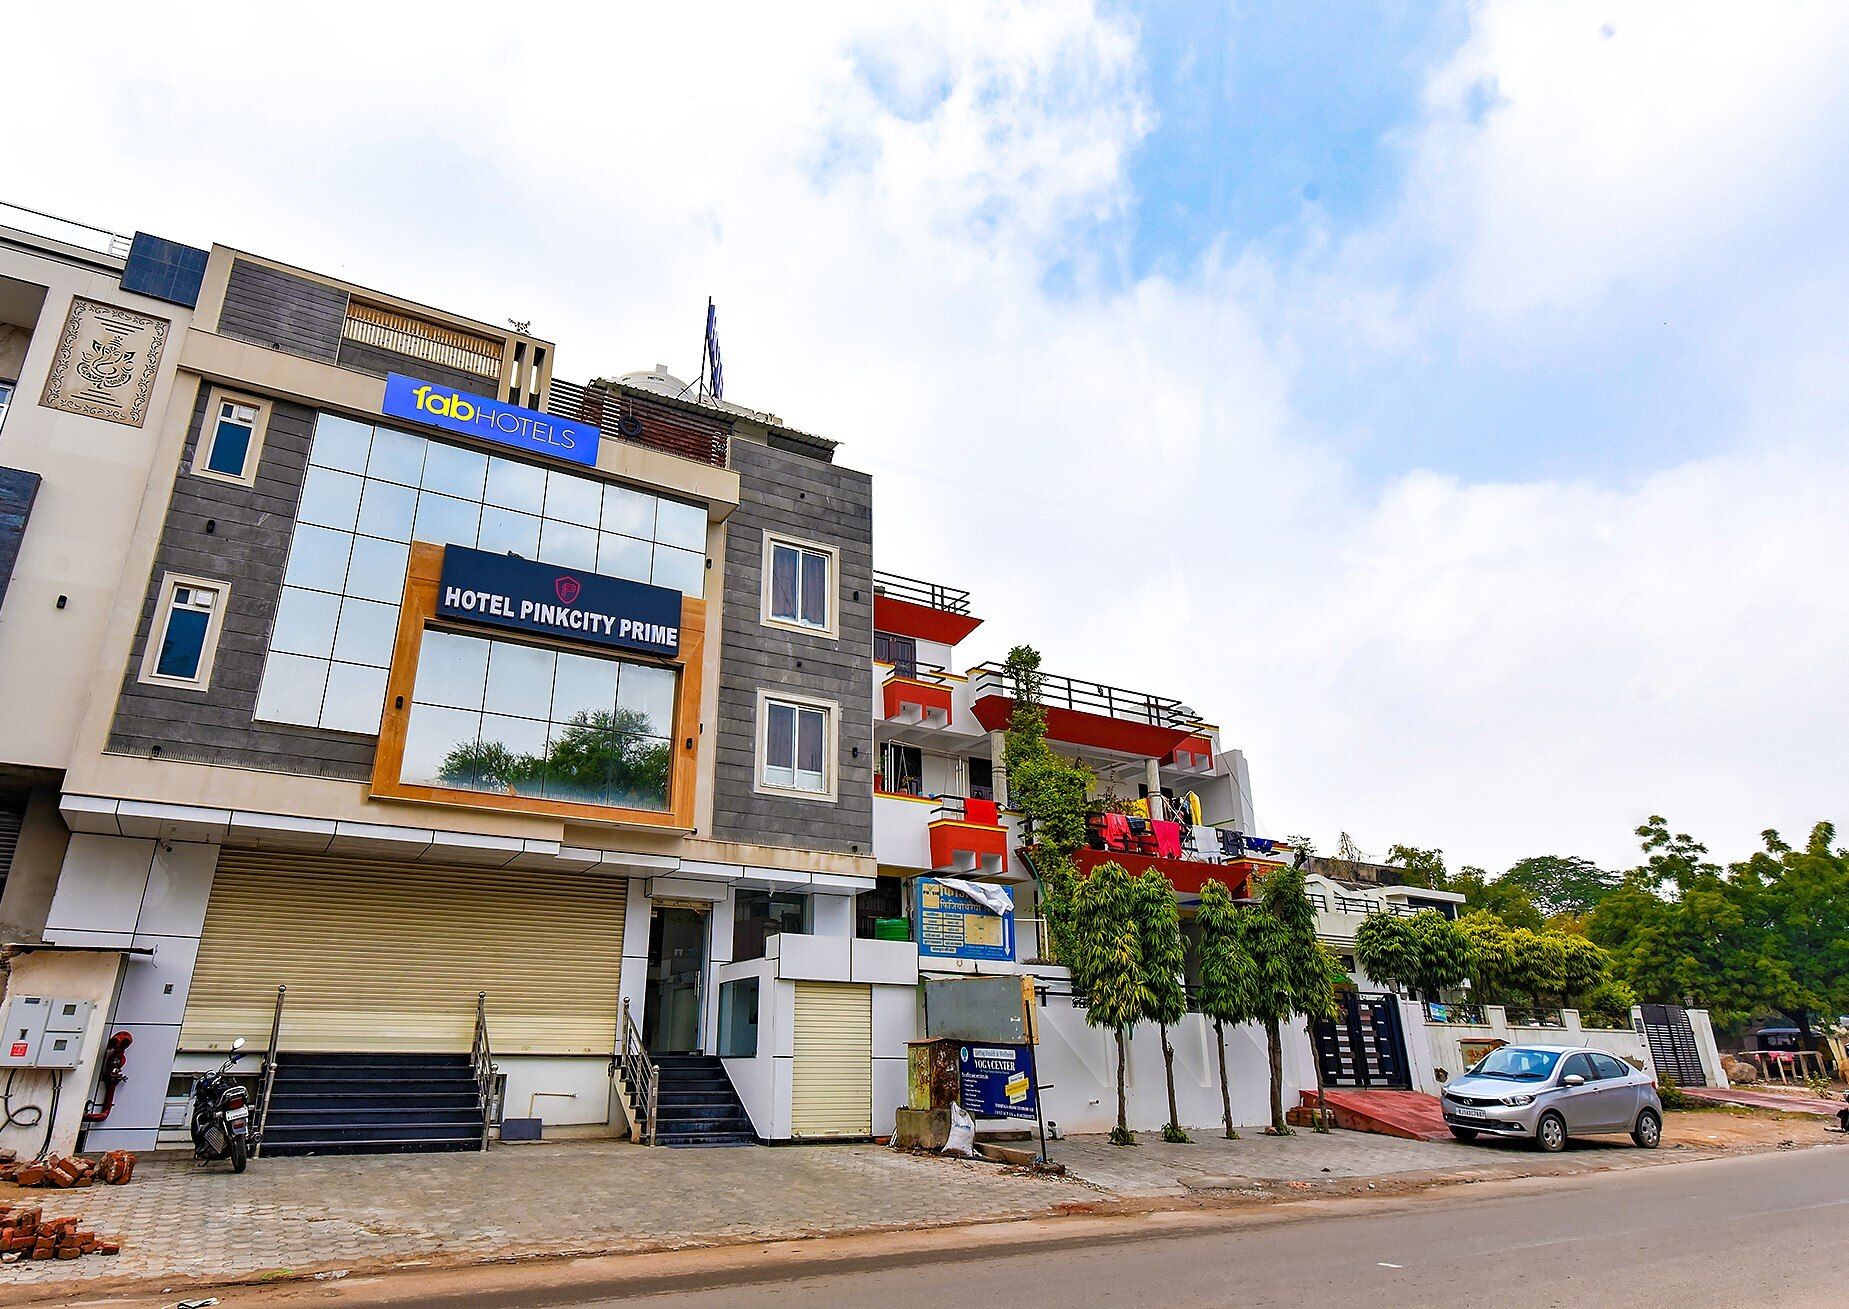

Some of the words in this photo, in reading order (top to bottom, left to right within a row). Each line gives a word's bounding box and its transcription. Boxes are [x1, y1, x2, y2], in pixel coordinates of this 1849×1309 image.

[444, 586, 515, 618] HOTEL
[519, 600, 616, 636] PINKCITY
[618, 619, 678, 647] PRIME
[974, 1059, 991, 1069] YOGA
[990, 1060, 1016, 1071] CENTER
